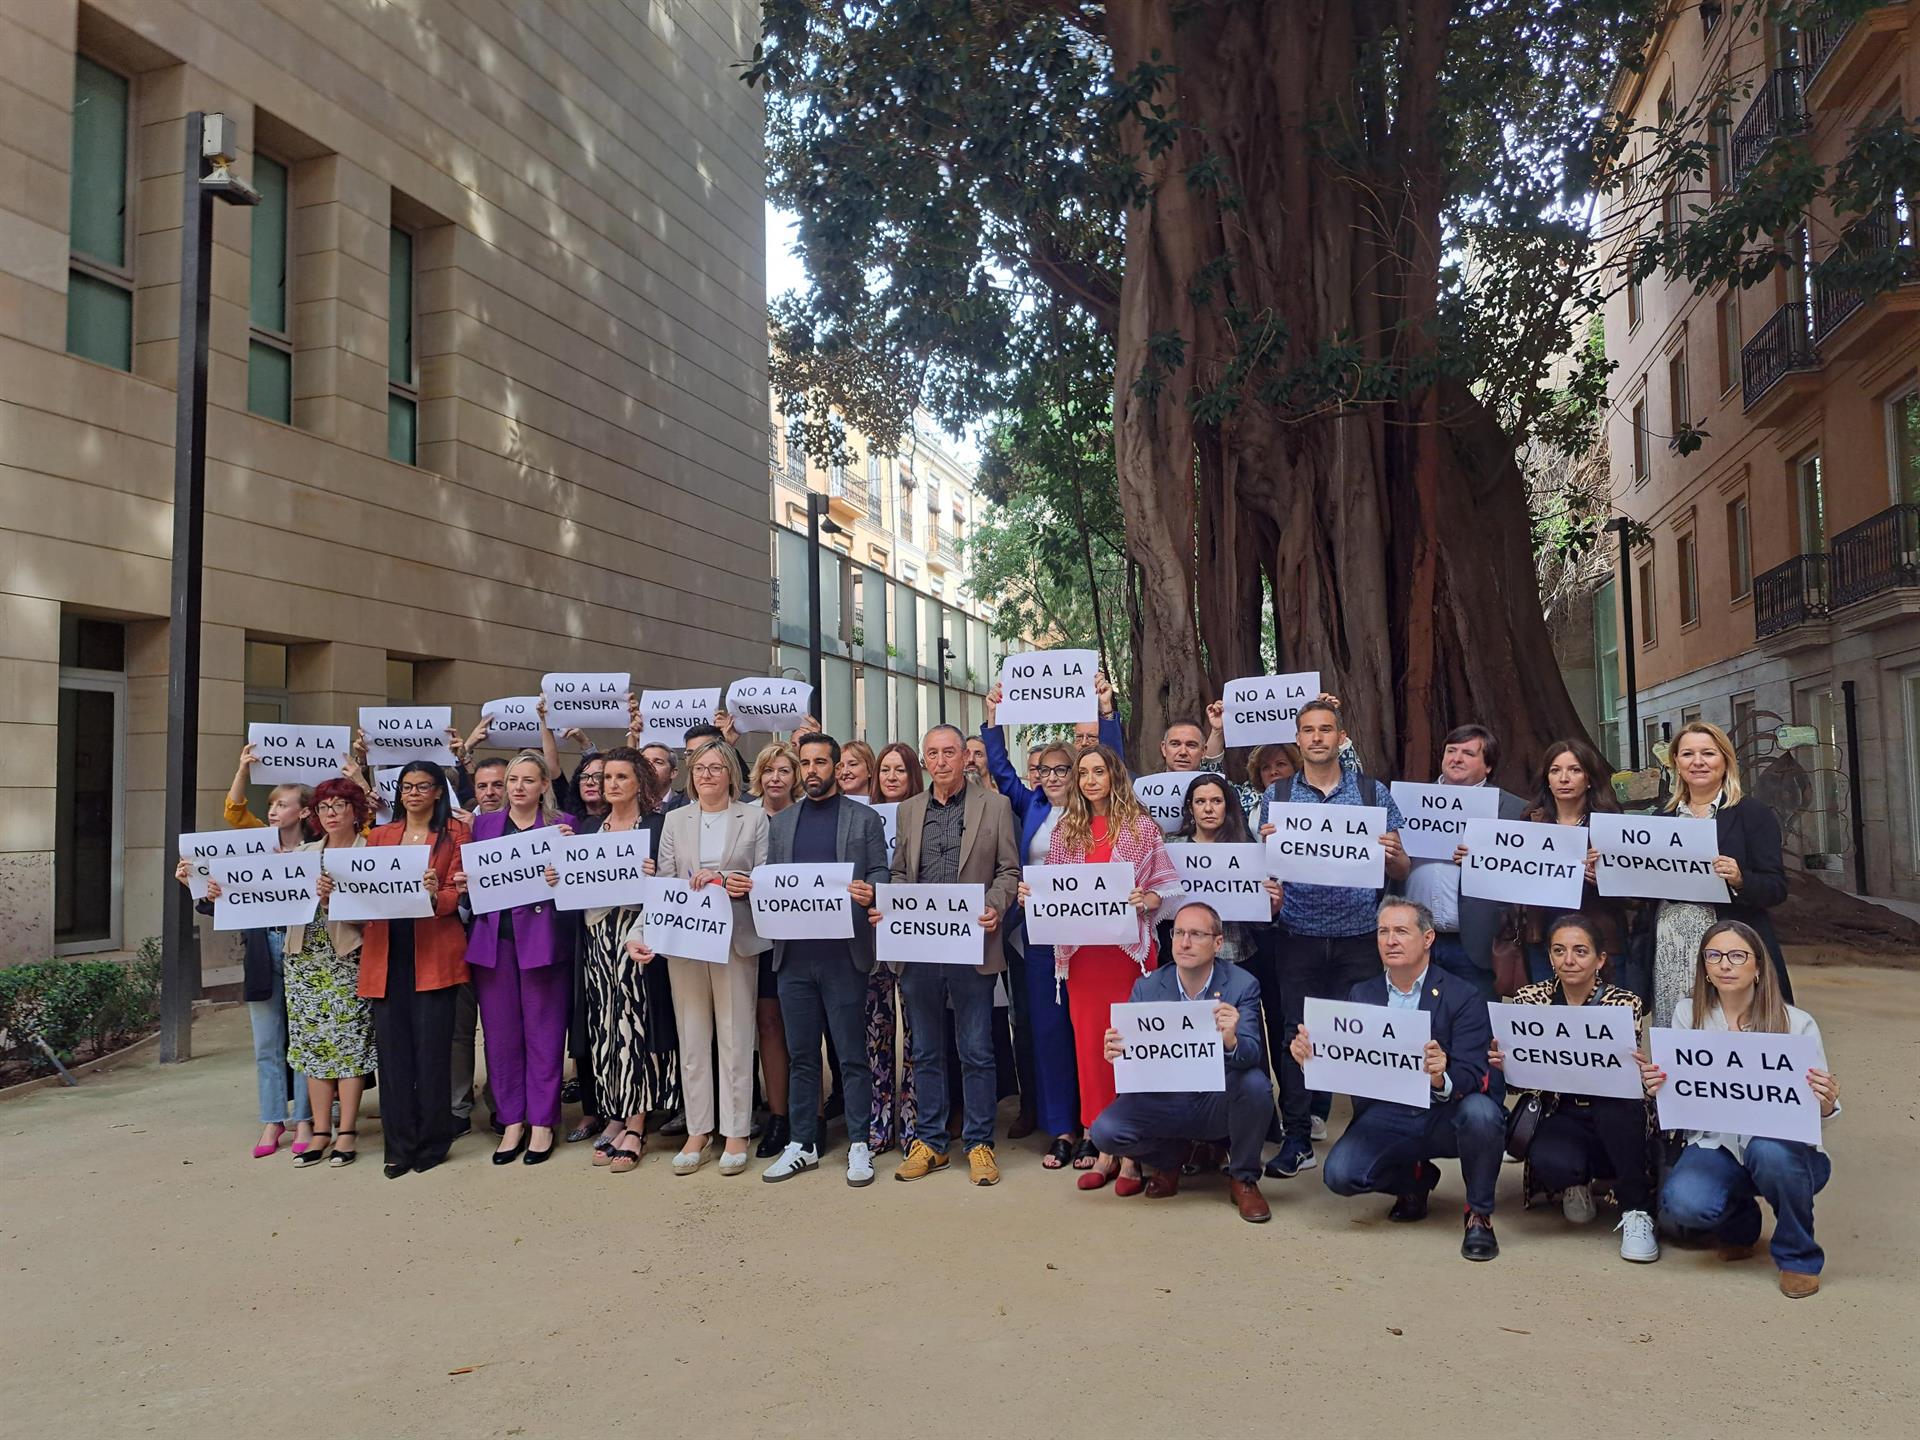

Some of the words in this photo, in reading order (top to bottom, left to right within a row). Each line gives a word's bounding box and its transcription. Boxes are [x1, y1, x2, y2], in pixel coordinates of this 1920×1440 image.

[1012, 666, 1034, 678] NO
[1043, 665, 1052, 676] A
[1064, 663, 1082, 675] LA
[555, 683, 575, 692] NO
[582, 683, 590, 692] A
[600, 683, 616, 692] LA
[737, 687, 757, 696] NO
[763, 687, 771, 695] A
[781, 687, 796, 695] LA
[1010, 686, 1085, 700] CENSURA
[1236, 690, 1257, 702] NO
[1266, 689, 1275, 700] A
[1287, 686, 1305, 698] LA
[505, 705, 524, 713] NO
[554, 700, 619, 710] CENSURA
[652, 700, 670, 709] NO
[675, 700, 683, 709] A
[692, 699, 706, 708] LA
[738, 703, 797, 715] CENSURA
[650, 717, 710, 728] CENSURA
[1235, 708, 1298, 724] CENSUR
[379, 719, 400, 729] NO
[404, 720, 412, 729] A
[417, 719, 432, 729] LA
[489, 721, 560, 731] L'OPACI
[265, 737, 287, 747] NO
[296, 737, 305, 747] A
[317, 738, 334, 749] LA
[374, 738, 443, 747] CENSURA
[262, 756, 337, 768] CENSURA
[1142, 785, 1163, 795] NO
[1171, 785, 1181, 796] A
[1422, 796, 1447, 809] NO
[1452, 798, 1462, 810] A
[1287, 818, 1312, 831] NO
[1321, 819, 1332, 832] A
[1347, 821, 1368, 835] LA
[1496, 833, 1524, 847] NO
[1542, 838, 1554, 851] A
[1622, 829, 1650, 844] NO
[1670, 833, 1682, 847] A
[195, 845, 217, 857] NO
[226, 844, 235, 855] A
[247, 842, 265, 853] LA
[479, 852, 502, 866] NO
[511, 848, 520, 859] A
[532, 841, 550, 855] LA
[567, 849, 588, 861] NO
[596, 847, 605, 859] A
[617, 844, 634, 857] LA
[1281, 841, 1369, 860] CENSURA
[352, 859, 375, 872] NO
[391, 858, 400, 870] A
[1187, 856, 1211, 868] NO
[1229, 856, 1239, 868] A
[1471, 855, 1576, 878] L'OPACITAT
[1602, 854, 1711, 874] L'OPACITAT
[228, 871, 253, 883] NO
[262, 869, 272, 880] A
[285, 866, 305, 878] LA
[480, 865, 545, 888] CENSUR
[565, 867, 638, 885] CENSURA
[775, 875, 798, 887] NO
[814, 875, 824, 887] A
[338, 881, 421, 893] L'OPACITAT
[1053, 878, 1078, 891] NO
[1095, 877, 1106, 890] A
[1181, 880, 1261, 893] OPACITAT
[229, 889, 310, 904] CENSURA
[664, 890, 687, 904] NO
[701, 896, 710, 908] A
[758, 898, 843, 912] L'OPACITAT
[893, 898, 917, 910] NO
[926, 898, 936, 910] A
[949, 899, 968, 911] LA
[1034, 902, 1128, 917] L'OPACITAT
[646, 913, 726, 934] L'OPACITAT
[891, 921, 971, 936] CENSURA
[1138, 1017, 1164, 1031] NO
[1183, 1016, 1193, 1029] A
[1335, 1017, 1363, 1034] NO
[1383, 1023, 1395, 1039] A
[1511, 1021, 1544, 1036] NO
[1556, 1023, 1570, 1037] A
[1586, 1024, 1613, 1040] LA
[1123, 1042, 1215, 1060] L'OPACITAT
[1313, 1043, 1422, 1070] L'OPACITAT
[1513, 1048, 1621, 1067] CENSURA
[1676, 1049, 1713, 1066] NO
[1727, 1051, 1743, 1068] A
[1762, 1053, 1793, 1071] LA
[1675, 1080, 1800, 1105] CENSURA
